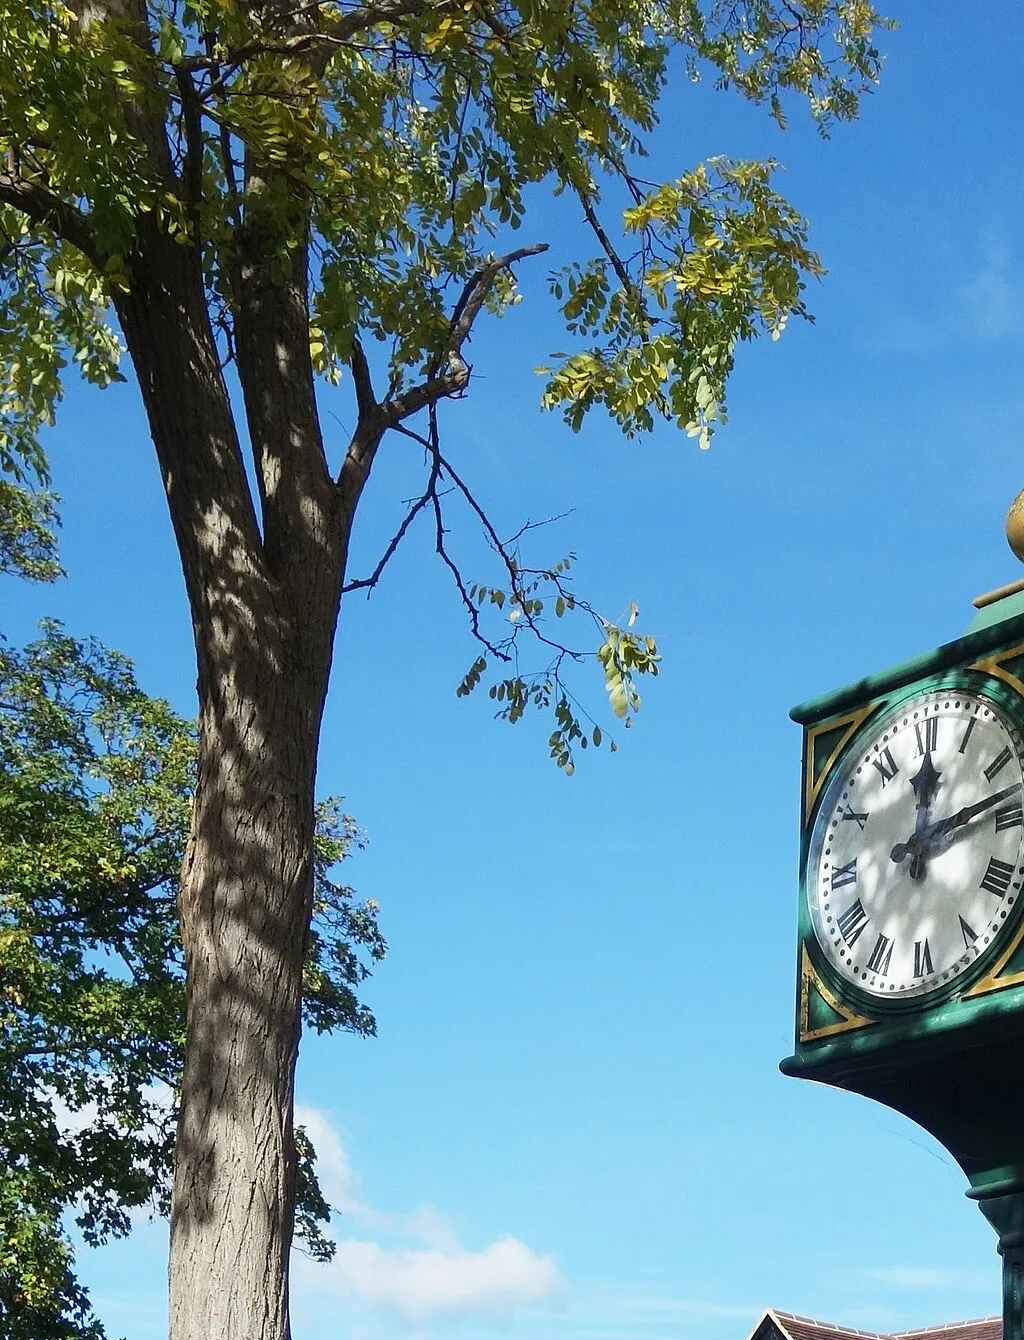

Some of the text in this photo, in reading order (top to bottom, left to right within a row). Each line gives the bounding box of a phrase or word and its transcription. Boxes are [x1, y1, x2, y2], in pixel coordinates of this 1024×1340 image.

[914, 716, 939, 759] XII
[959, 716, 977, 754] I
[872, 746, 899, 789] XI
[983, 745, 1014, 784] II
[841, 804, 869, 831] X
